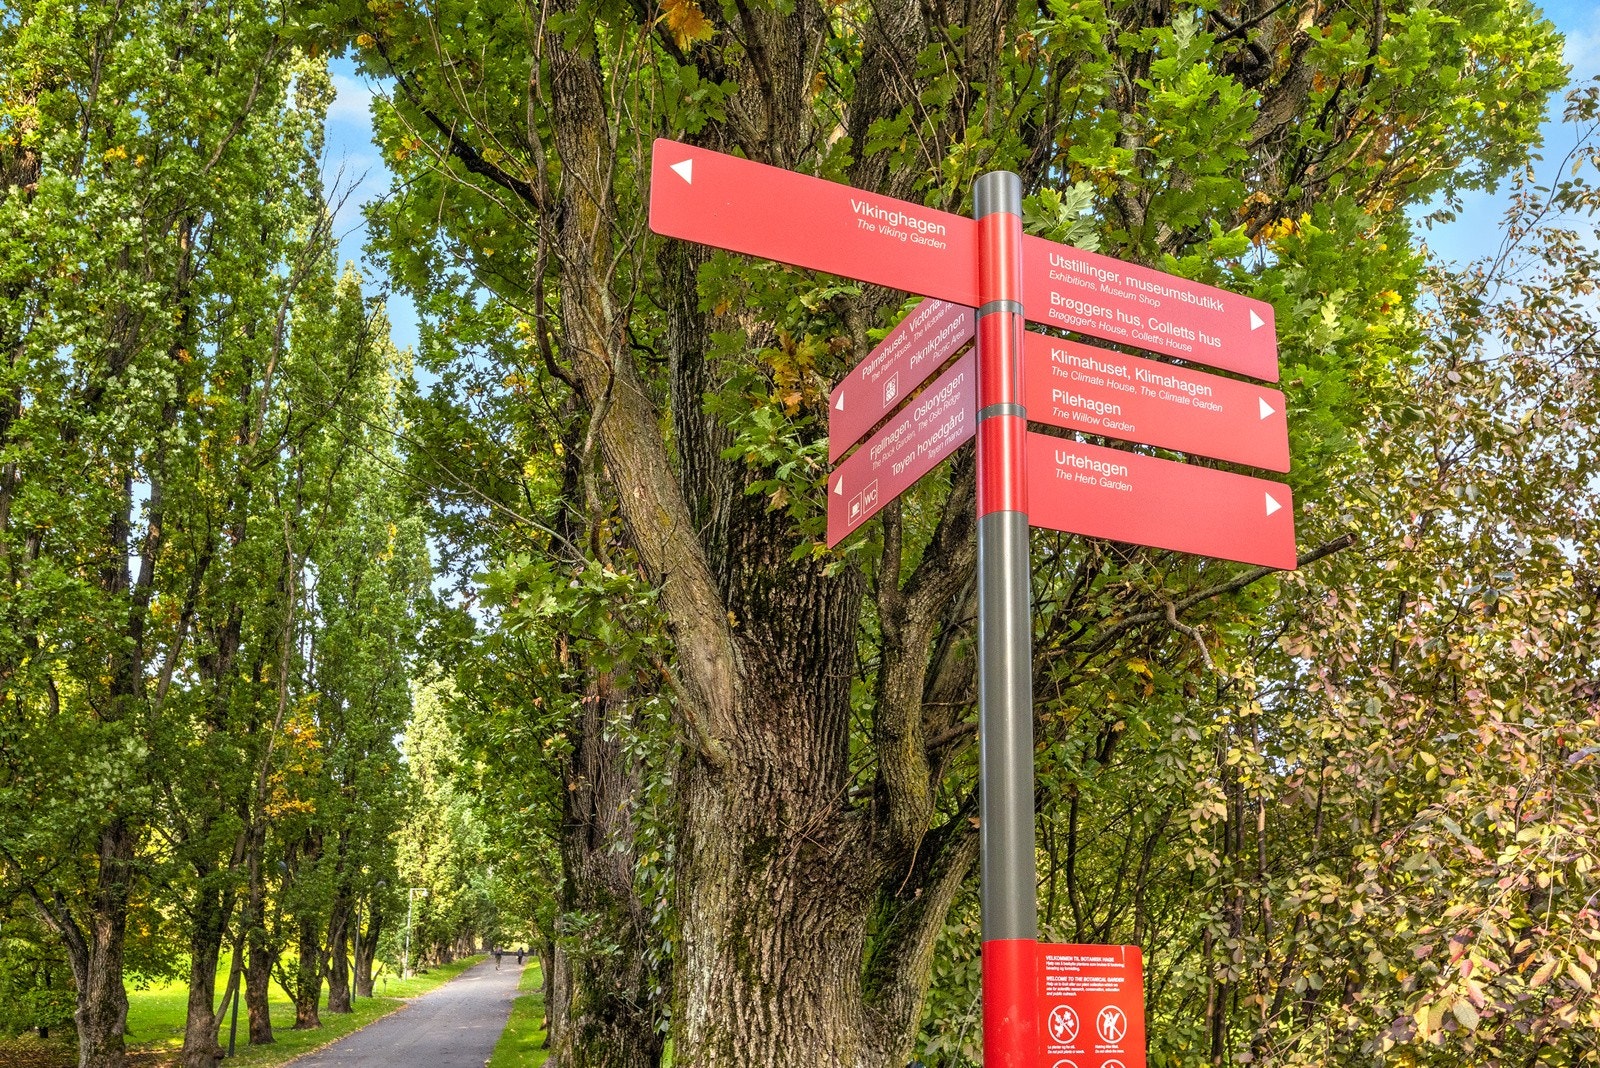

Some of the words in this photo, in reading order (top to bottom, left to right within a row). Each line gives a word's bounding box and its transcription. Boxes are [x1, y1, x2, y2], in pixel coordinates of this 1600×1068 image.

[851, 199, 946, 236] Vikinghagen
[857, 218, 876, 232] The
[879, 225, 908, 242] Viking
[910, 233, 947, 250] Garden
[1049, 252, 1122, 286] Utstillinger,
[1126, 276, 1225, 313] museumsbutikk
[1049, 270, 1098, 291] Exhibitions,
[1100, 284, 1137, 300] Museum
[1139, 294, 1161, 308] Shop
[1050, 291, 1113, 319] Brøggers
[1117, 309, 1144, 329] hus,
[1148, 318, 1195, 341] Colletts
[1199, 331, 1221, 348] hus
[1099, 321, 1129, 338] House,
[1165, 338, 1192, 352] House
[862, 330, 908, 380] Palmehuset,
[871, 372, 881, 383] The
[881, 358, 894, 375] Palm
[914, 329, 924, 342] The
[910, 313, 965, 369] Piknikplenen
[932, 342, 951, 362] Picnic
[951, 329, 965, 344] Area
[1051, 348, 1131, 380] Klimahuset,
[1135, 367, 1212, 397] Klimahagen
[1051, 366, 1069, 378] The
[1071, 370, 1105, 386] Climate
[1107, 379, 1137, 394] House,
[1140, 386, 1157, 398] The
[1158, 390, 1190, 405] Climate
[1192, 396, 1223, 412] Garden
[870, 420, 912, 461] Fjellhagen,
[914, 372, 964, 421] Osloryggen
[1052, 388, 1121, 416] Pilehagen
[1072, 411, 1101, 426] Willow
[1102, 417, 1136, 432] Garden
[872, 458, 882, 470] The
[882, 448, 895, 463] Rock
[918, 419, 929, 432] The
[929, 406, 943, 422] Oslo
[943, 392, 961, 411] Ridge
[891, 451, 915, 476] Tøyen
[917, 408, 964, 456] hovedgård
[1055, 449, 1128, 477] Urtehagen
[1055, 468, 1073, 481] The
[1074, 472, 1097, 486] Herb
[1099, 477, 1133, 492] Garden
[864, 490, 877, 506] WC
